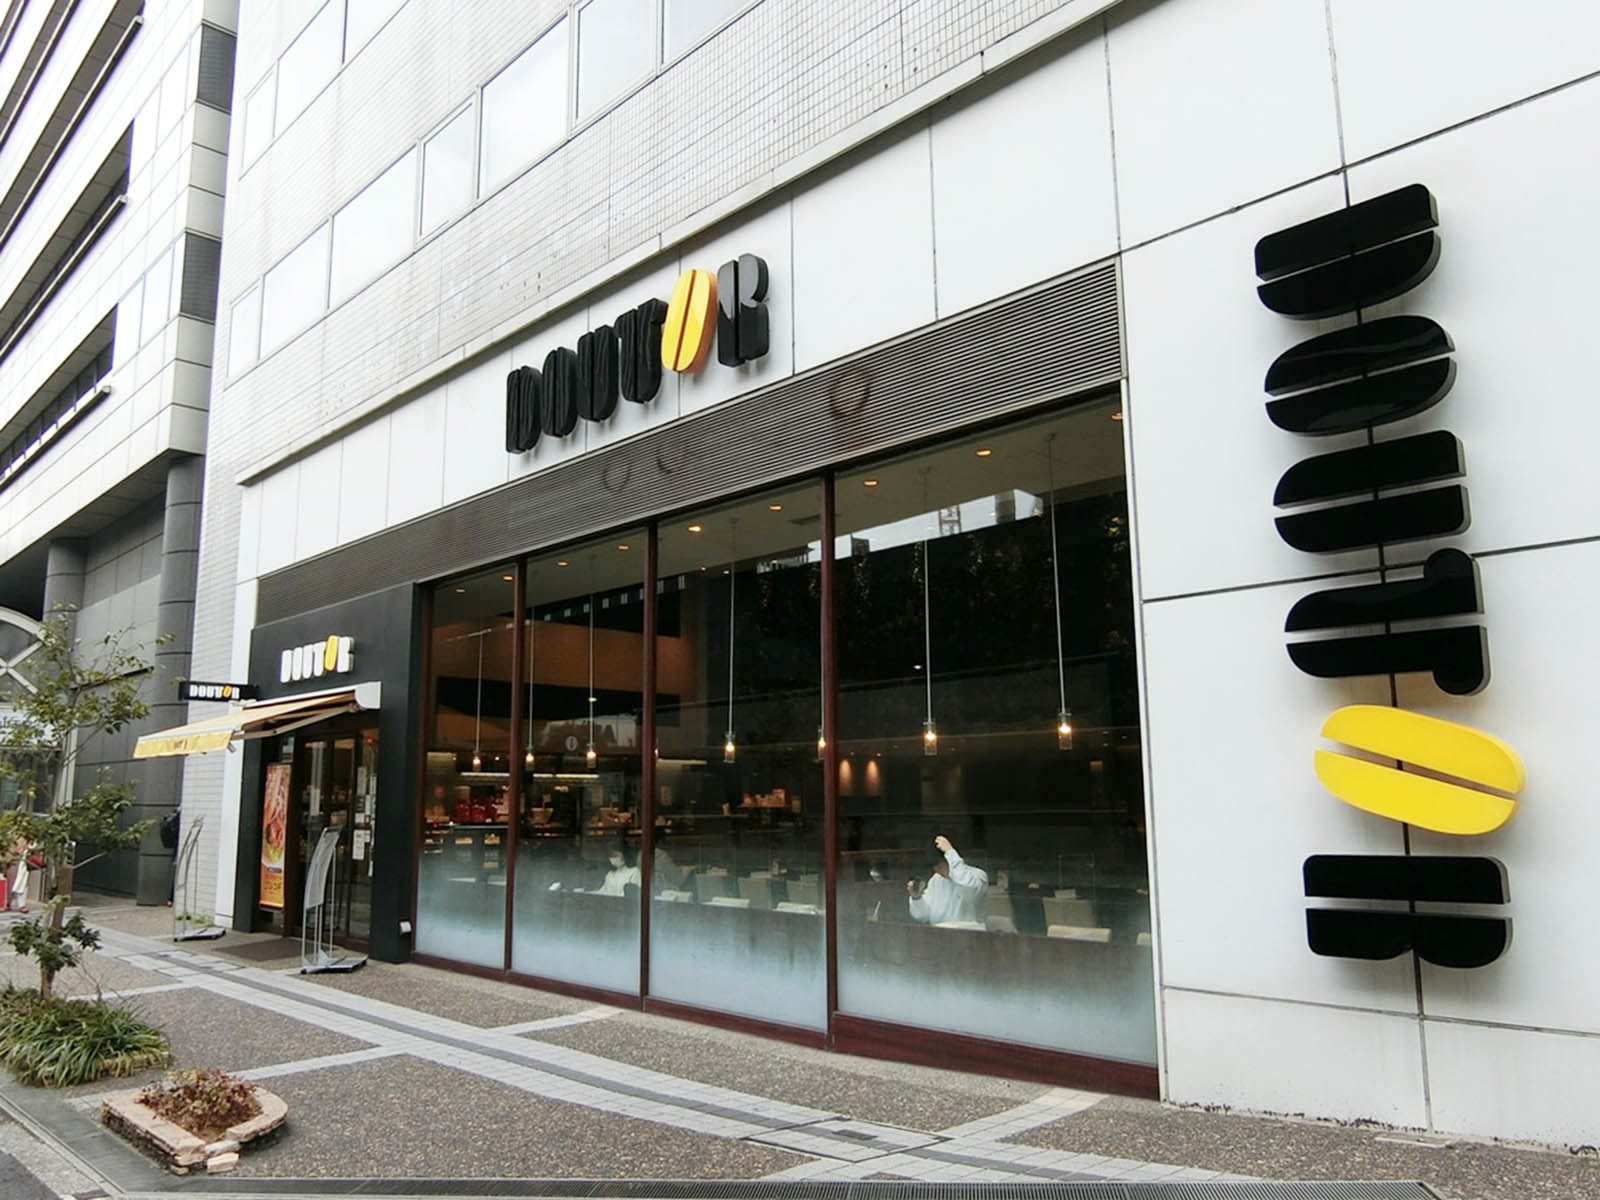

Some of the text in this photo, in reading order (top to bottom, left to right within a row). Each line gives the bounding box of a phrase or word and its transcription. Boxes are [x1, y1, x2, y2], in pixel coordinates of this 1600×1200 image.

[506, 253, 770, 454] DOUTOR
[1255, 183, 1525, 969] DOUTOR
[189, 685, 240, 698] DOUTOR
[280, 635, 355, 683] DOUTOR
